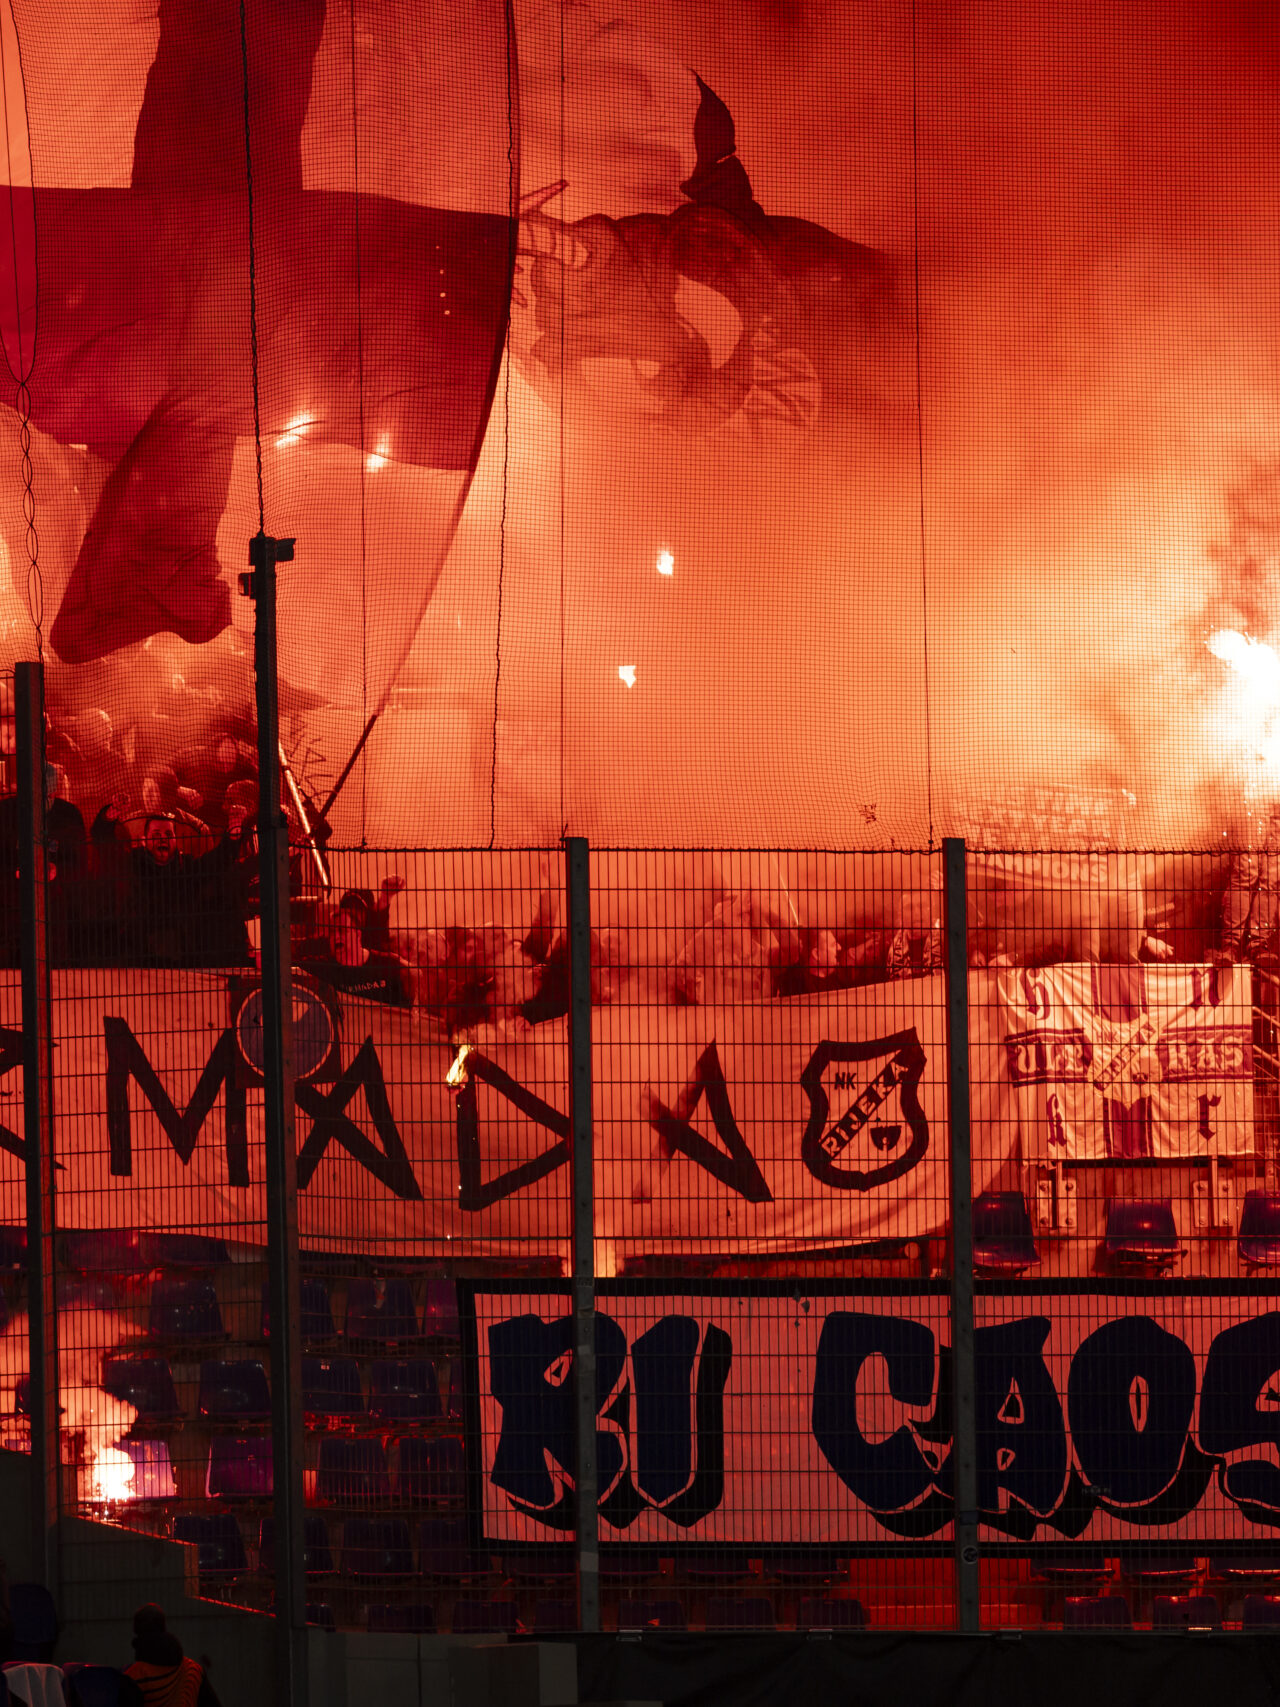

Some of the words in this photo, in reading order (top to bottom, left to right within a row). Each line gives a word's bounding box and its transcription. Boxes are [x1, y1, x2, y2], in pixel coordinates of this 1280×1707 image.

[967, 853, 1109, 884] AMPIONS
[834, 1072, 857, 1091] NK
[488, 1312, 730, 1528] RI
[812, 1311, 1280, 1540] CAOS
